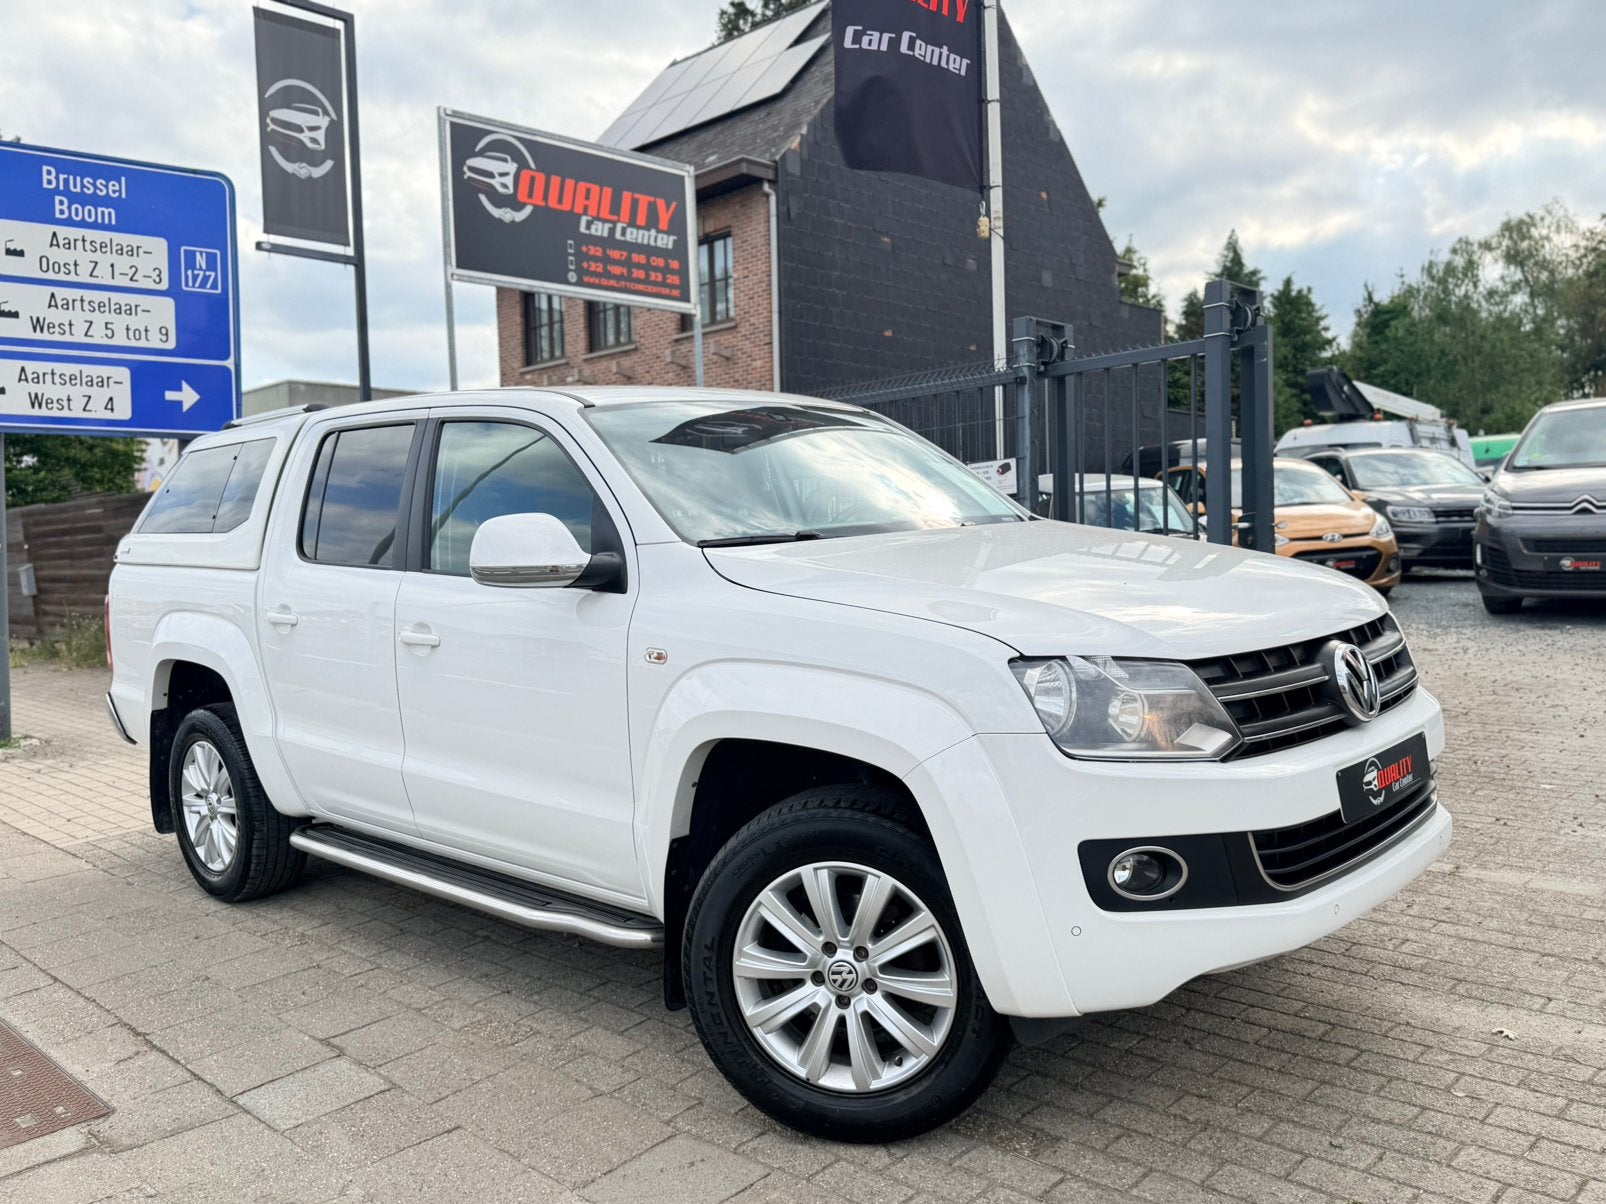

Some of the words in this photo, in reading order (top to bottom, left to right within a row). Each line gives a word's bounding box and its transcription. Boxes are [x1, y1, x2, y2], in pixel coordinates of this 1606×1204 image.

[843, 25, 896, 51] Car
[900, 30, 971, 77] Center
[41, 164, 127, 199] Brussel
[54, 195, 116, 225] Boom
[517, 168, 677, 231] QUALITY
[49, 230, 153, 258] Aartselaar-
[579, 215, 613, 241] Car
[615, 222, 678, 249] Center
[196, 251, 207, 269] N
[581, 244, 603, 257] +32
[39, 255, 80, 277] Oost
[186, 269, 215, 289] 177
[582, 260, 604, 273] +32
[47, 292, 151, 317] Aartselaar-
[30, 316, 75, 337] West
[125, 324, 150, 342] tot
[159, 326, 169, 343] 9
[18, 366, 123, 388] Aartselaar-
[28, 392, 73, 411] West
[1377, 755, 1413, 789] QUALITY
